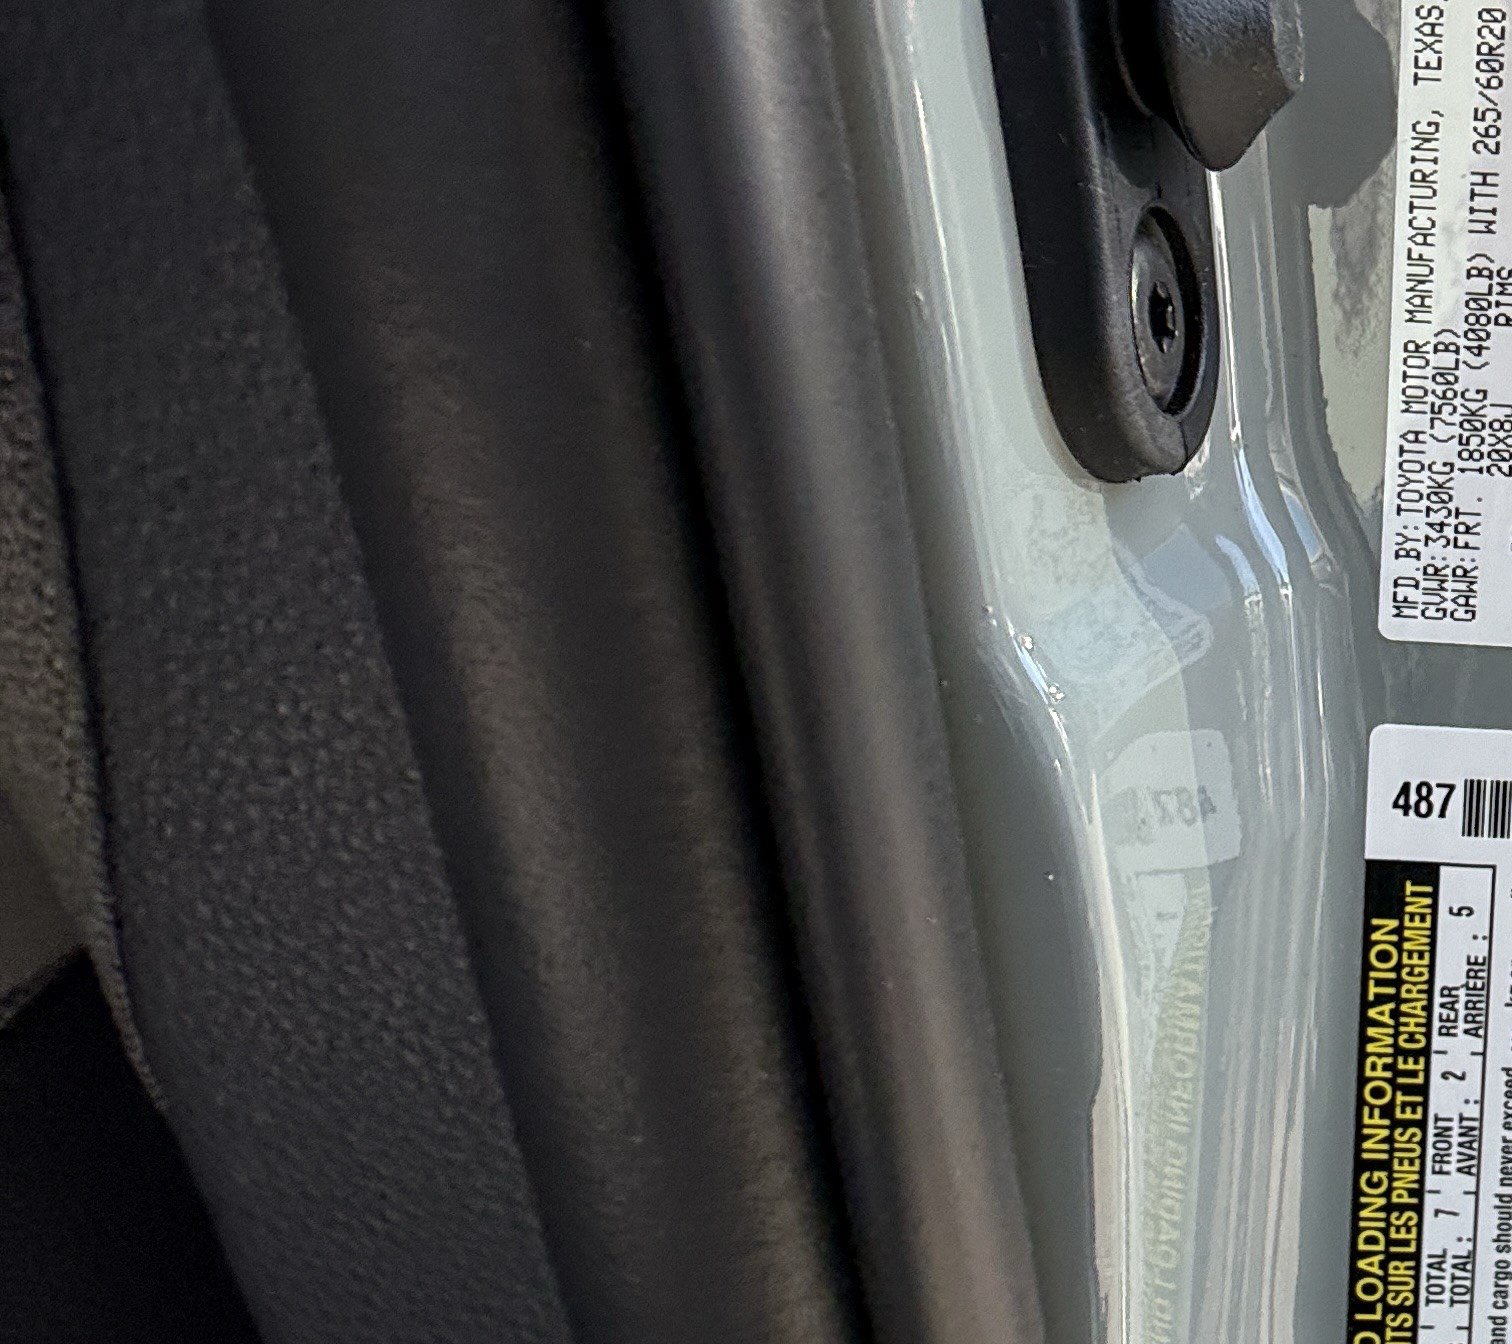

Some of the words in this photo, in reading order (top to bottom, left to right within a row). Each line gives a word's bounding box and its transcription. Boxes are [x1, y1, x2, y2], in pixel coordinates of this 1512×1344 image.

[1472, 7, 1507, 156] 265/60R20
[1404, 110, 1443, 325] MANUFACTURING,
[1467, 171, 1500, 235] WITH
[1461, 253, 1495, 370] (4080LB)
[1400, 339, 1431, 415] MOTOR
[1428, 328, 1461, 444] (7560LB)
[1457, 387, 1488, 475] 1850KG
[1392, 780, 1457, 819] 487
[1448, 905, 1475, 918] 5
[1397, 880, 1433, 1049] CHARGEMENT
[1361, 918, 1400, 1160] INFORMATION
[1437, 985, 1461, 1038] REAR
[1396, 1056, 1425, 1084] LE
[1440, 1070, 1467, 1081] 2
[1394, 1090, 1424, 1120] ET
[1391, 1127, 1423, 1204] PNEUS
[1431, 1113, 1454, 1176] FRONT
[1389, 1210, 1418, 1253] LES
[1433, 1208, 1460, 1219] 7
[1354, 1170, 1389, 1321] LOADING
[1386, 1260, 1416, 1307] SUR
[1424, 1248, 1448, 1307] TOTAL
